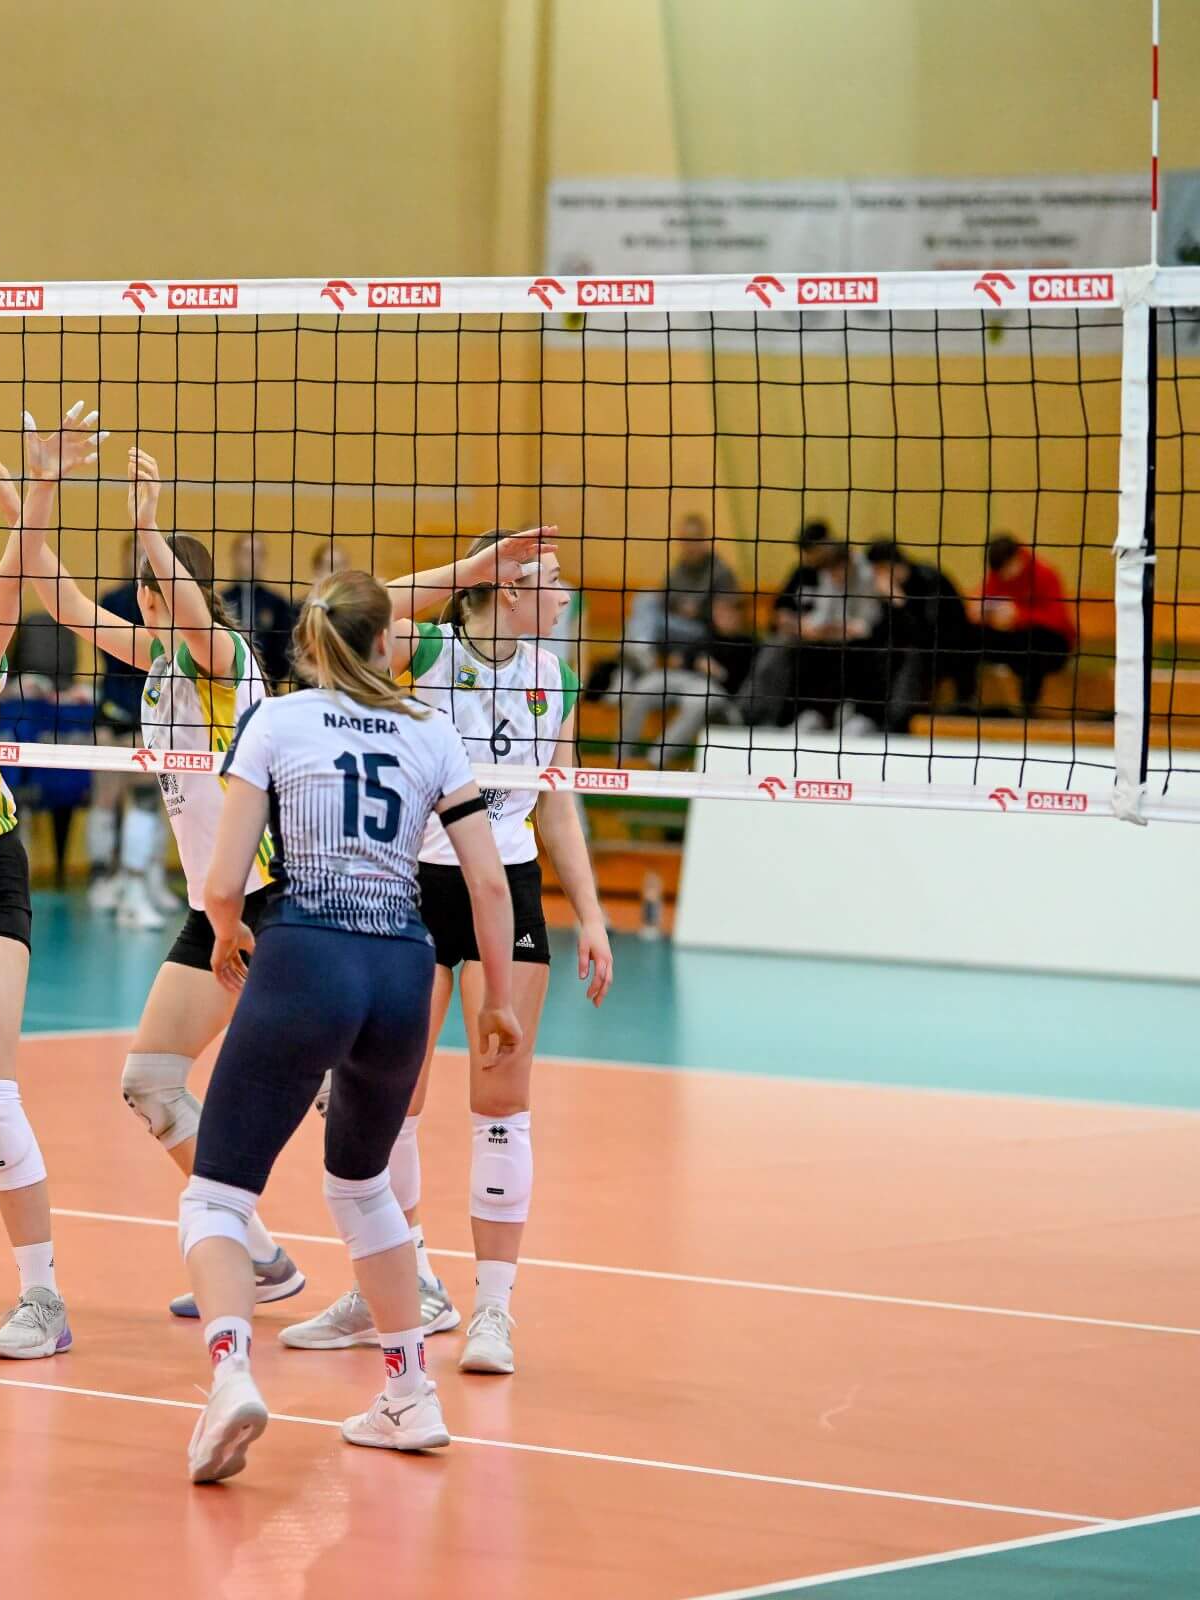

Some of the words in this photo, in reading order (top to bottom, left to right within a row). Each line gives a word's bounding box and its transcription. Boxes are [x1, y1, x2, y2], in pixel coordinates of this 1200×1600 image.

[170, 287, 235, 306] ORLEN
[371, 285, 437, 305] ORLEN
[580, 283, 650, 303] ORLEN
[800, 281, 874, 301] ORLEN
[1032, 277, 1110, 300] ORLEN
[323, 713, 401, 734] NADERA
[490, 718, 511, 757] 6
[166, 754, 211, 770] ORLEN
[576, 773, 627, 790] ORLEN
[796, 783, 850, 799] ORLEN
[1029, 794, 1085, 811] ORLEN
[333, 751, 402, 843] 15
